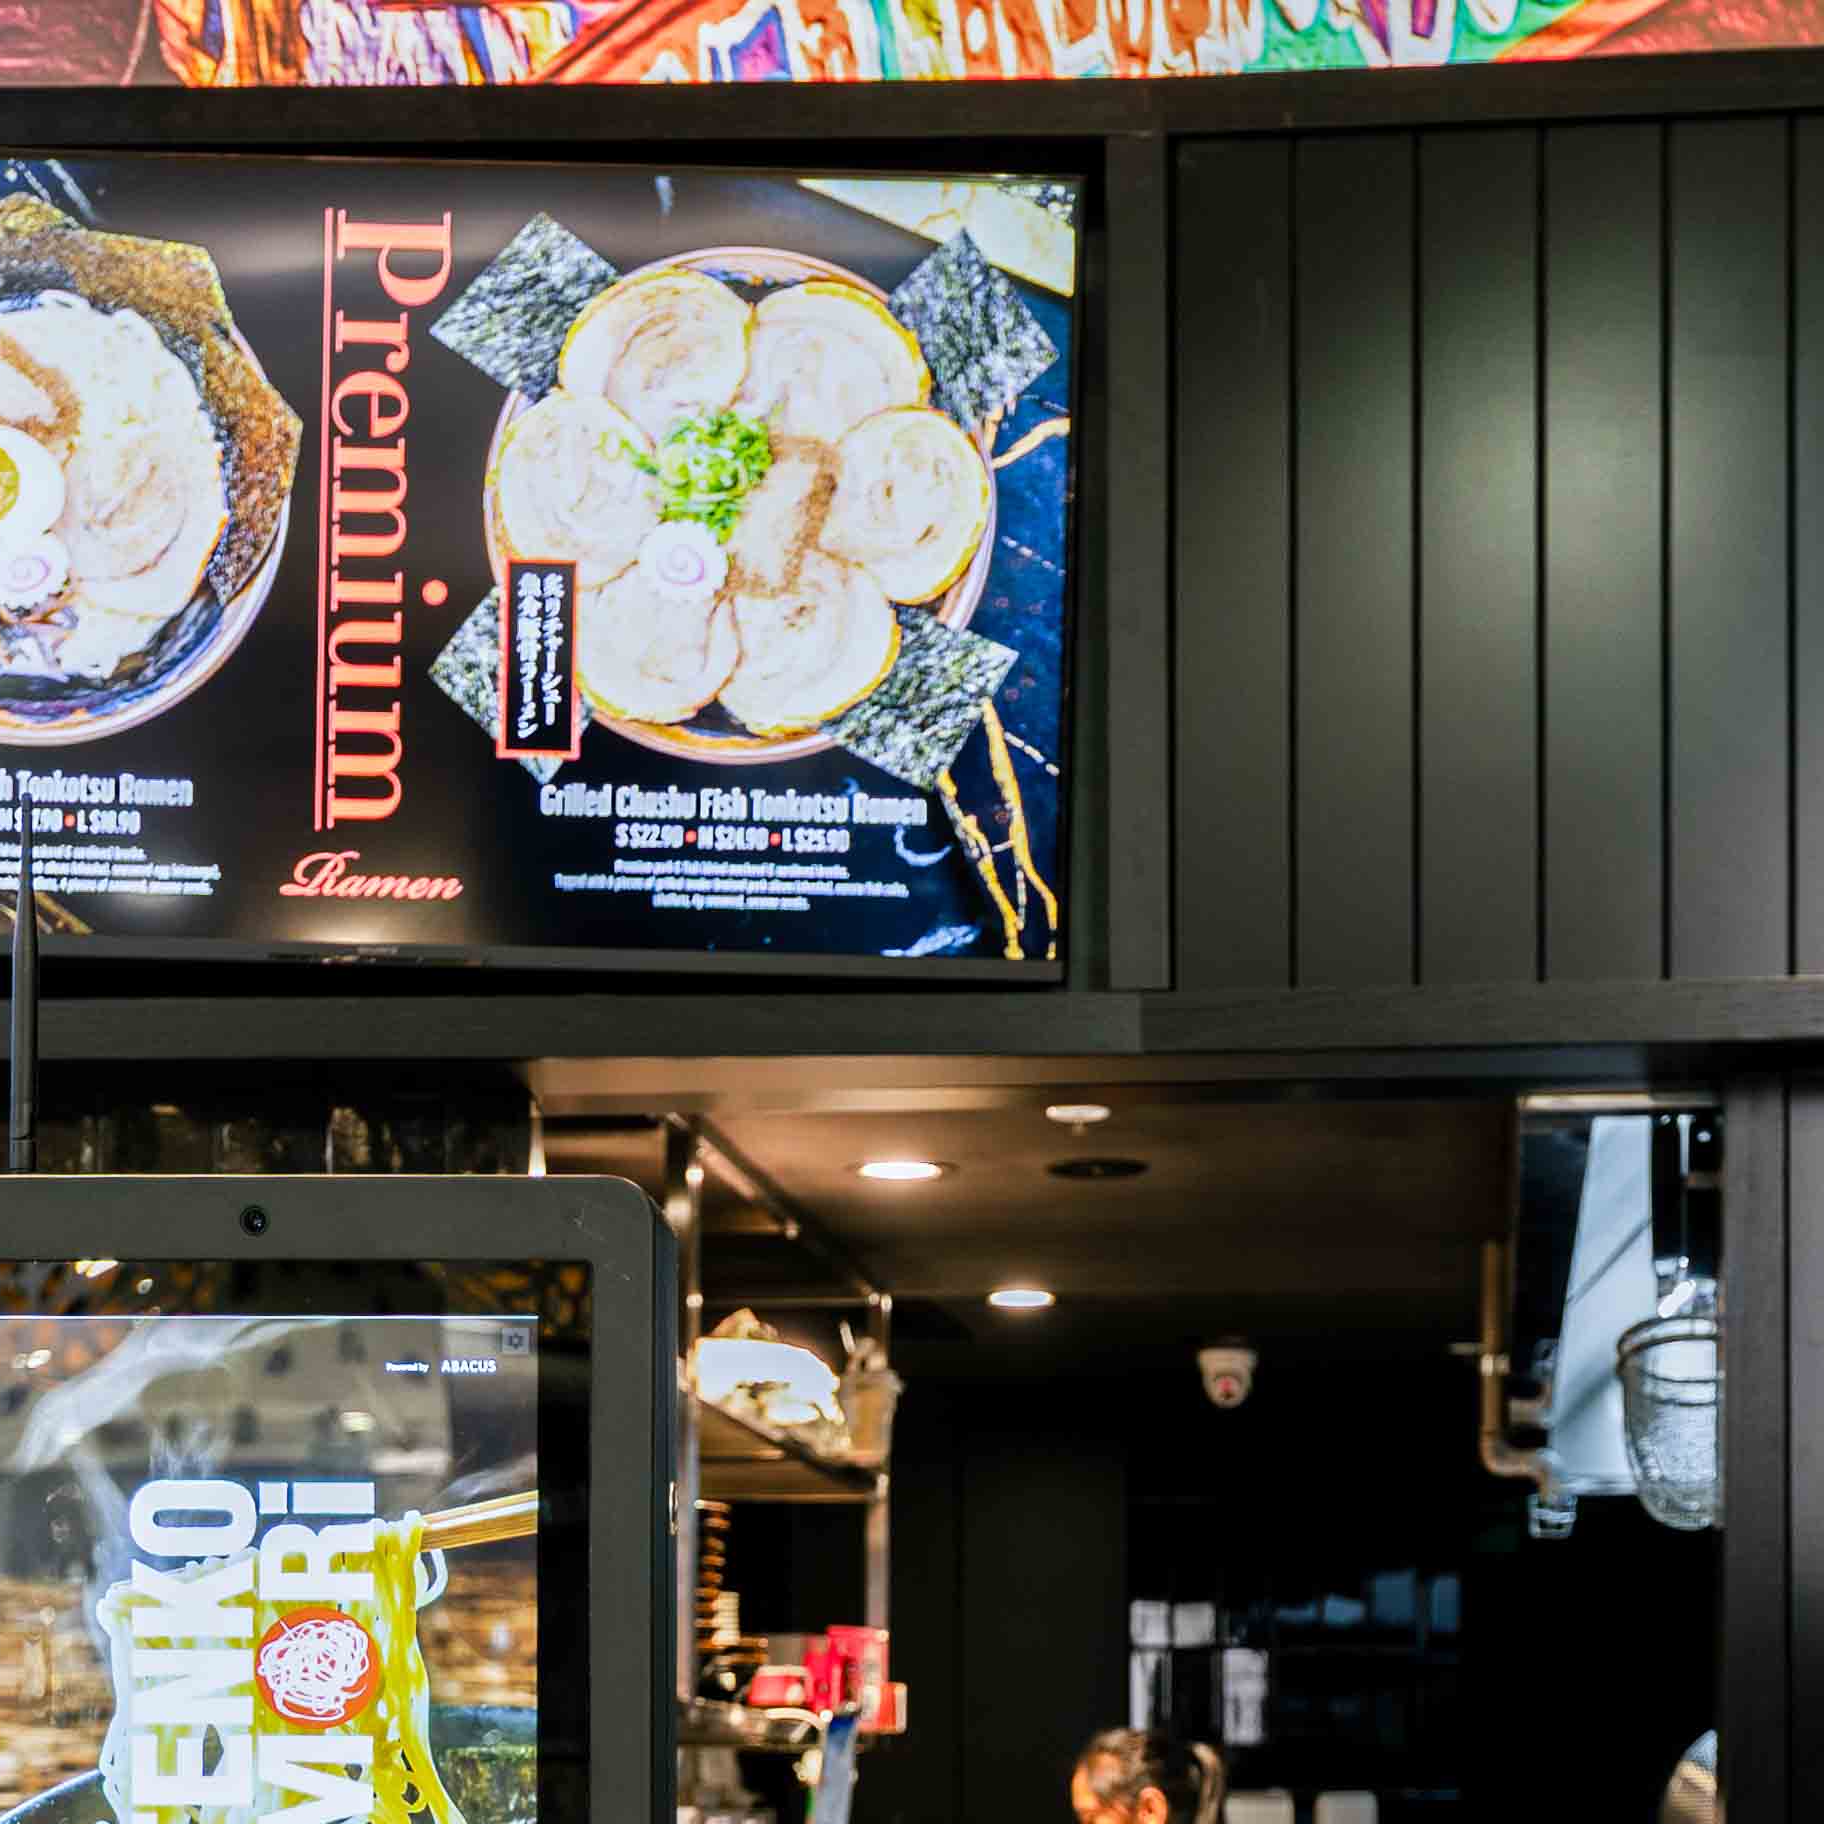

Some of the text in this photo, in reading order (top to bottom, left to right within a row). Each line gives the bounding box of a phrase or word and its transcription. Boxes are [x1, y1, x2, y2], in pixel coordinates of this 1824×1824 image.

[326, 209, 453, 829] Premium
[118, 773, 194, 806] Ramen
[540, 783, 612, 817] Grilled
[615, 785, 696, 819] Chashu
[700, 787, 747, 820] Fish
[750, 788, 849, 823] Tonkotsu
[279, 851, 464, 901] Ramen
[441, 1359, 497, 1373] ABACUS
